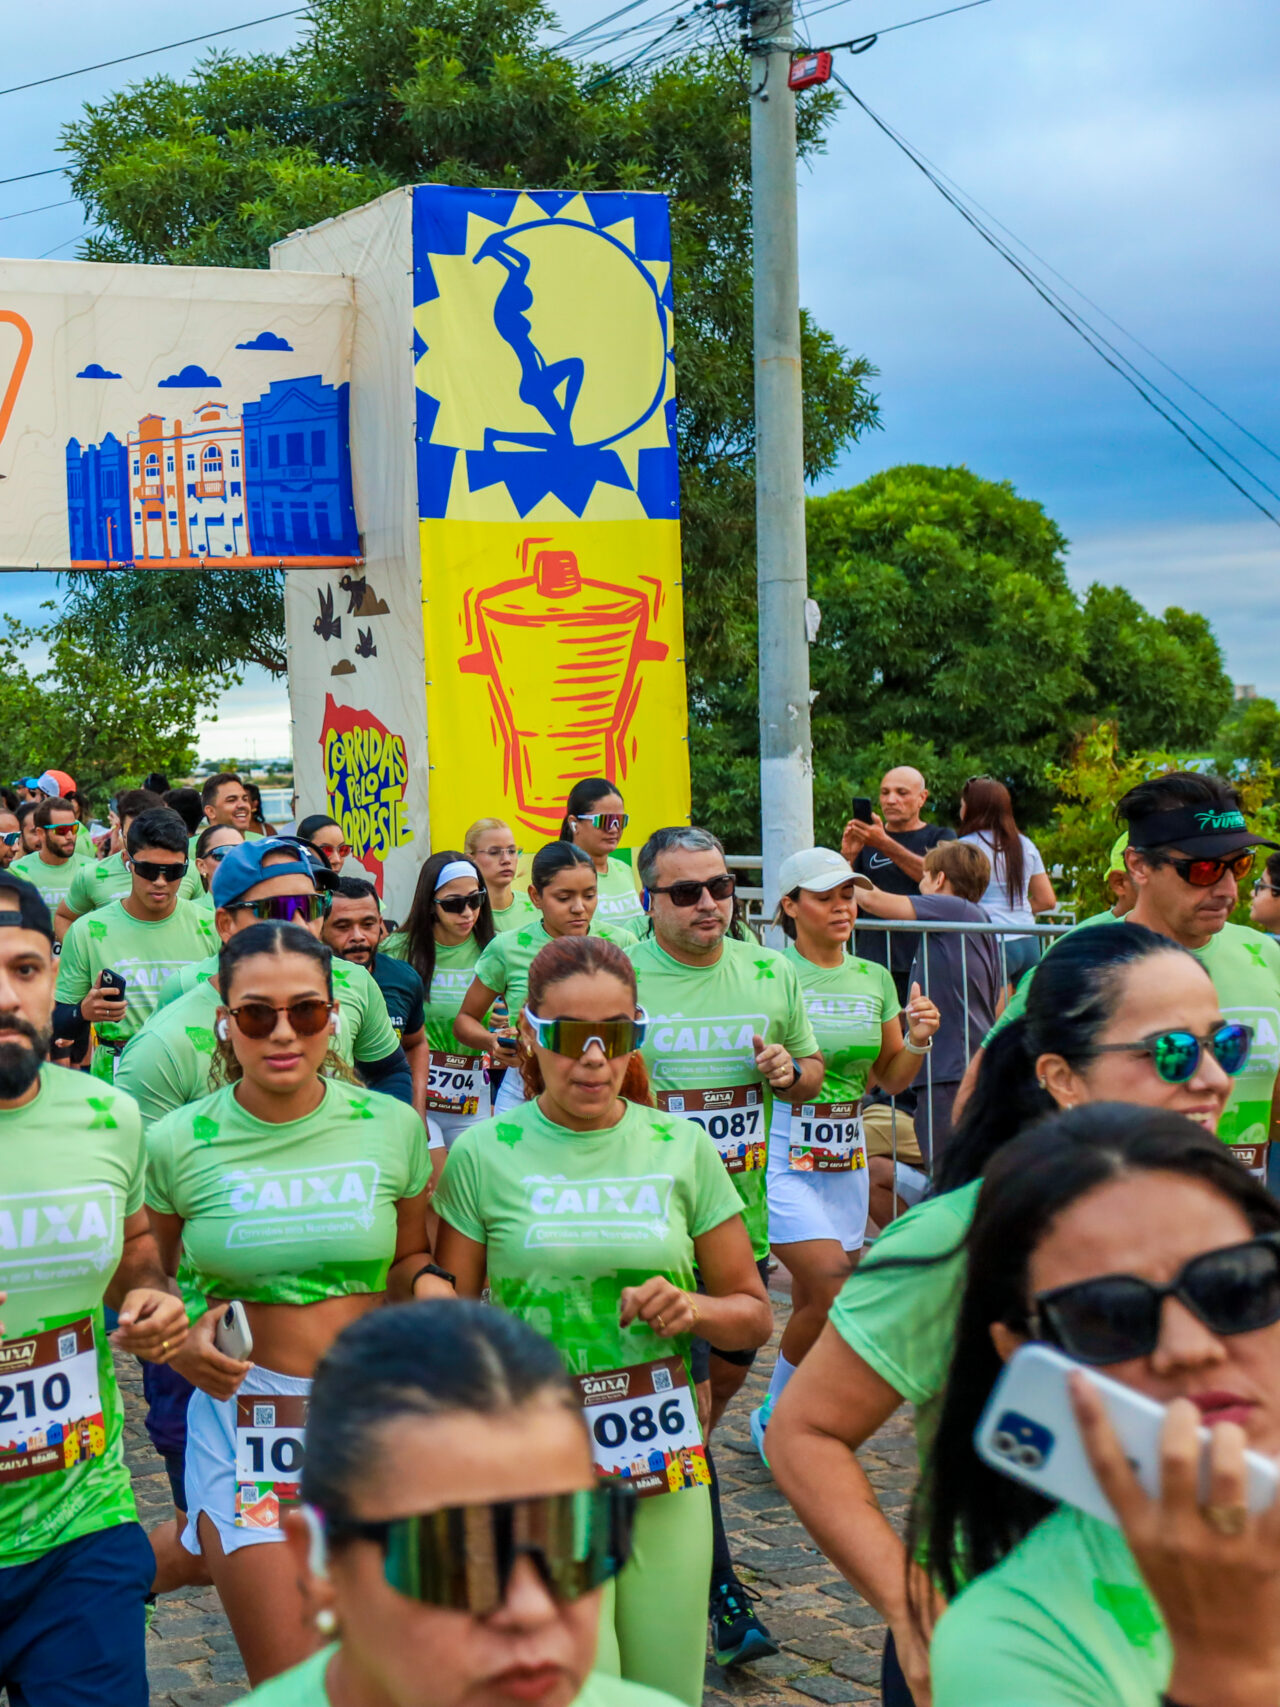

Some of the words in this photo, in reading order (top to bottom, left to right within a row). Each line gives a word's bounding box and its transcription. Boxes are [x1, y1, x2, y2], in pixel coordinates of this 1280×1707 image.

[324, 725, 409, 793] CORRIDAS
[327, 785, 414, 862] NORDESTE
[653, 1024, 755, 1052] CAIXA
[704, 1092, 732, 1102] CAIXA
[801, 1122, 860, 1144] 10194
[230, 1172, 368, 1213] CAIXA
[530, 1185, 662, 1214] CAIXA
[583, 1377, 626, 1395] CAIXA
